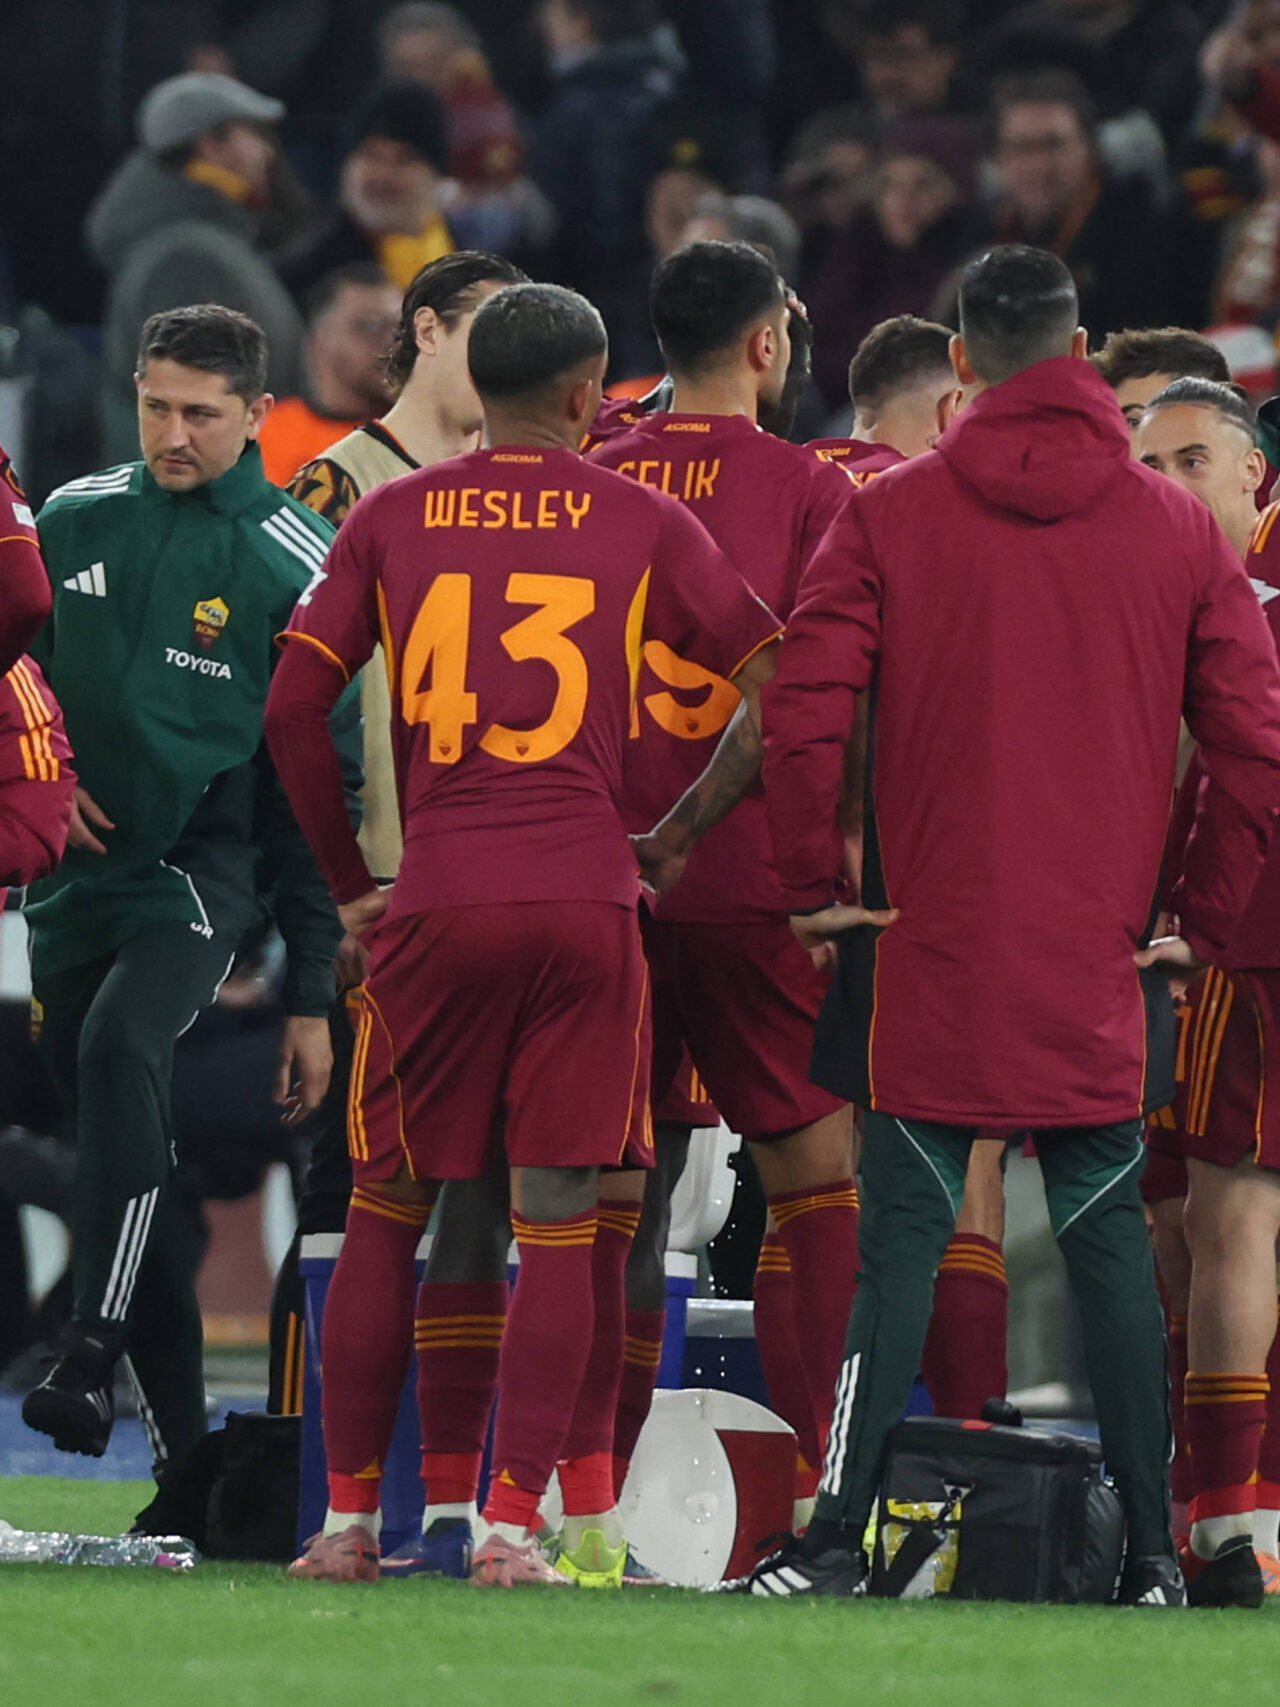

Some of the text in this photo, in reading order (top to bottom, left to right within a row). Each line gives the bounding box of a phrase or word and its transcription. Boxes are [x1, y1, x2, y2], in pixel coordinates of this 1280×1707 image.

[423, 488, 592, 530] WESLEY
[165, 646, 233, 680] TOYOTA
[401, 572, 596, 765] 43
